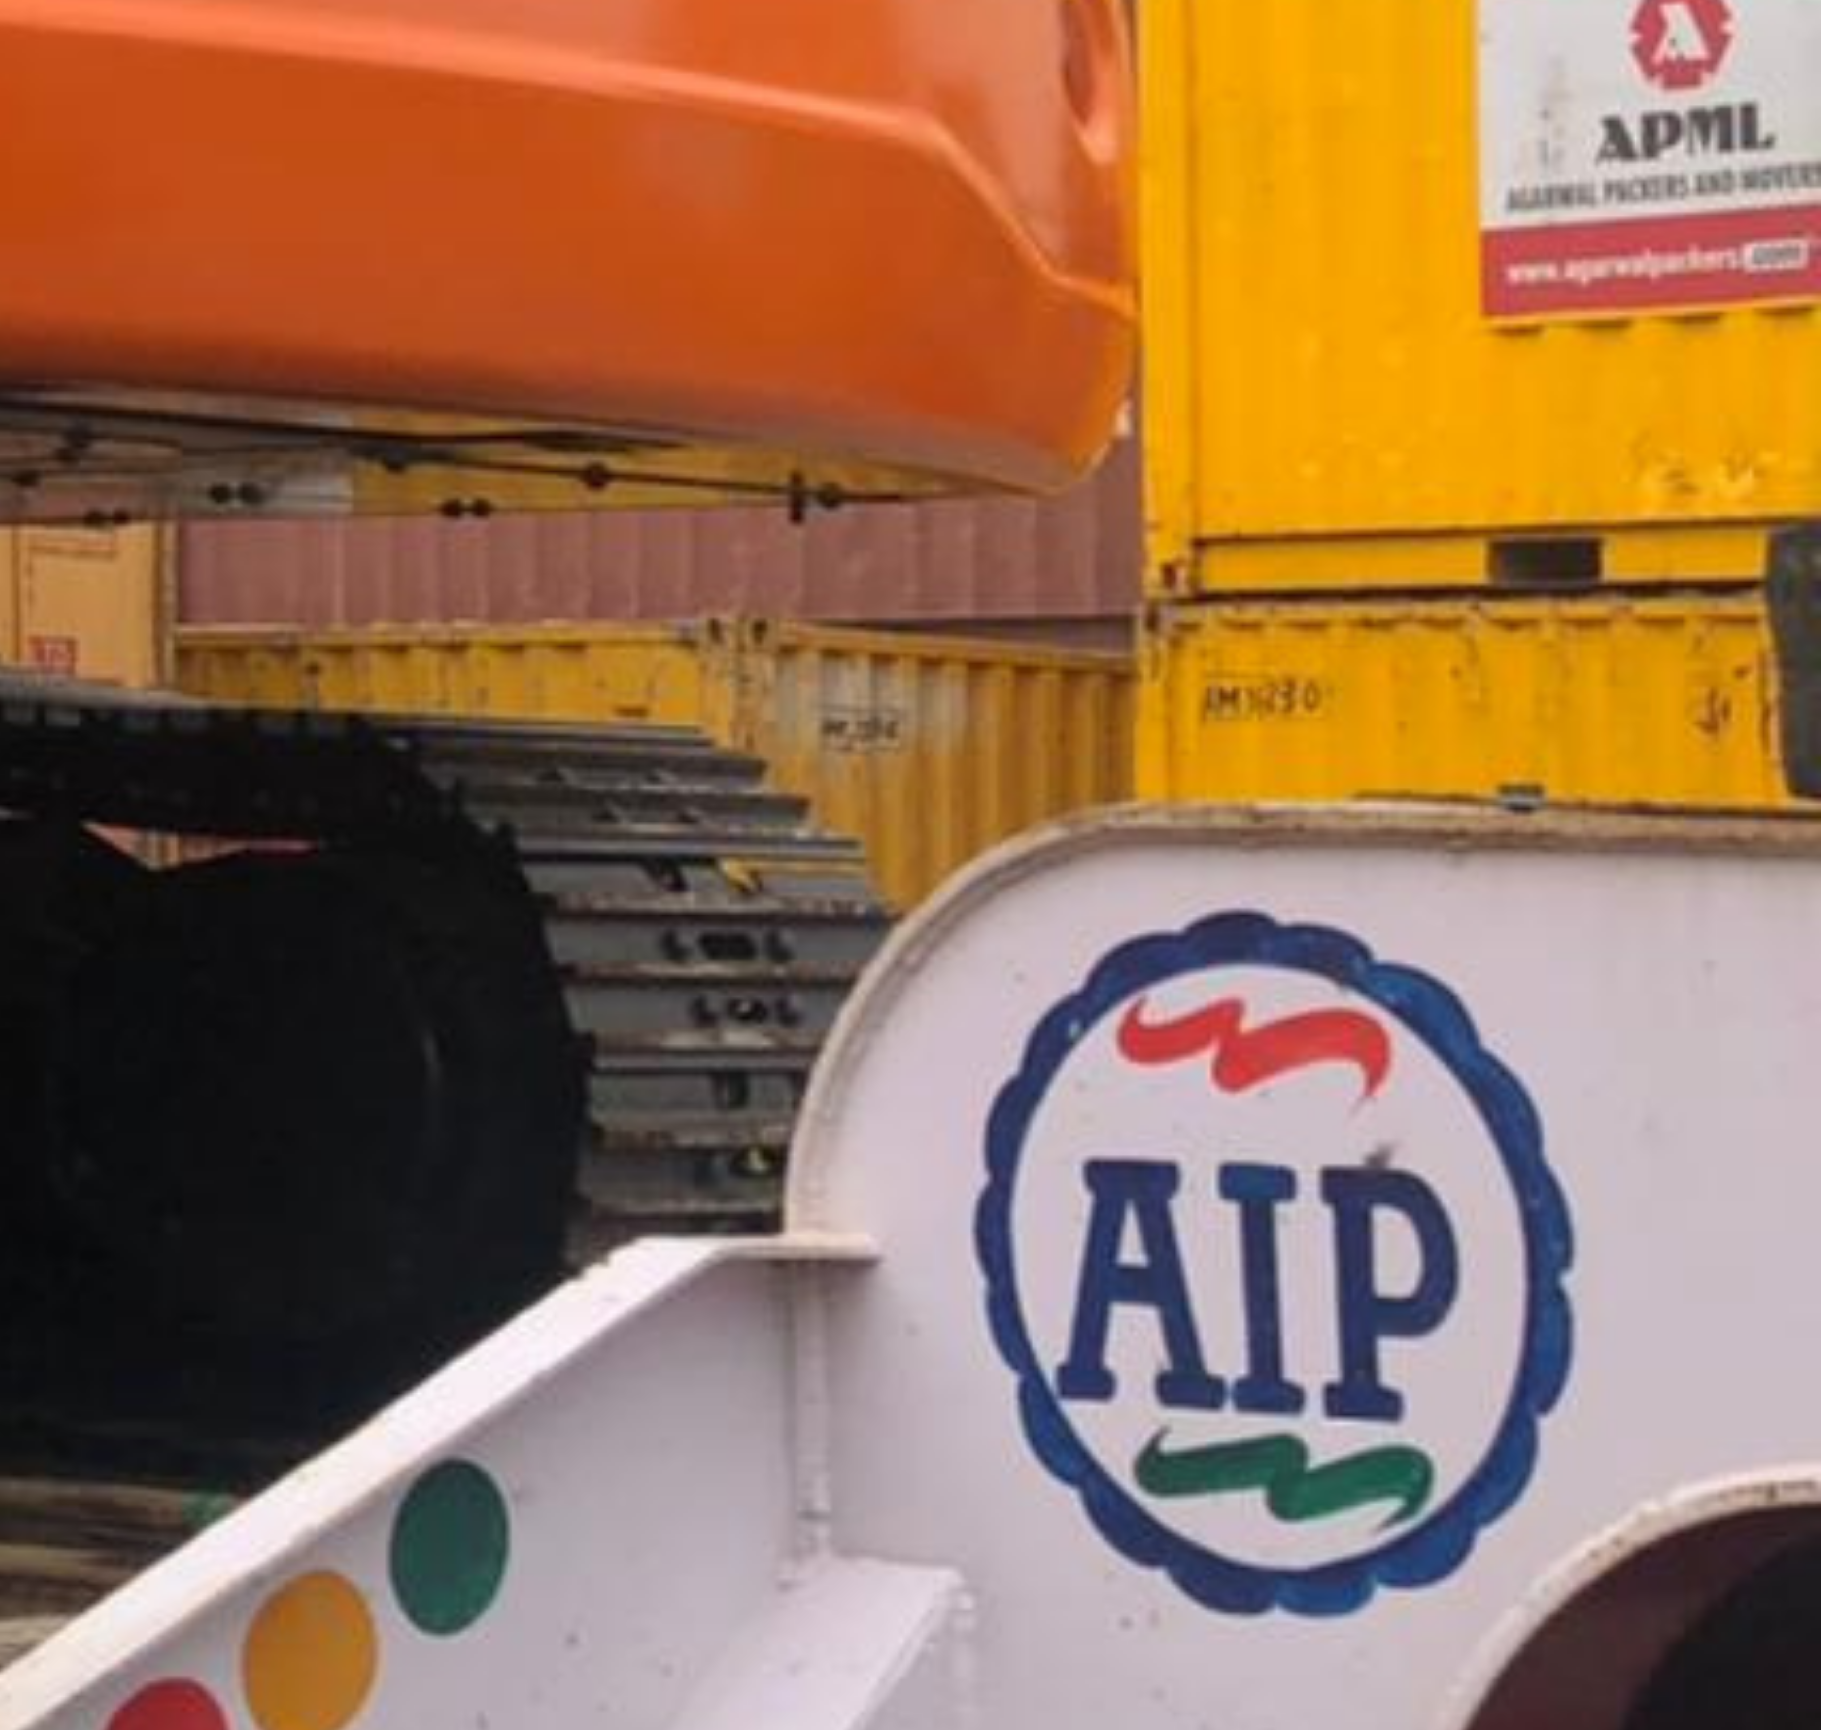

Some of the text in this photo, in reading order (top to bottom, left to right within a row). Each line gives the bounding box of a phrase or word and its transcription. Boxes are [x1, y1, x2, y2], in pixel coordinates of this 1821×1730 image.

[1595, 102, 1775, 165] APML
[1506, 181, 1597, 211] AGARWAL
[1603, 173, 1689, 204] PACKERS
[1695, 167, 1735, 196] AND
[1056, 1158, 1460, 1423] AIP
